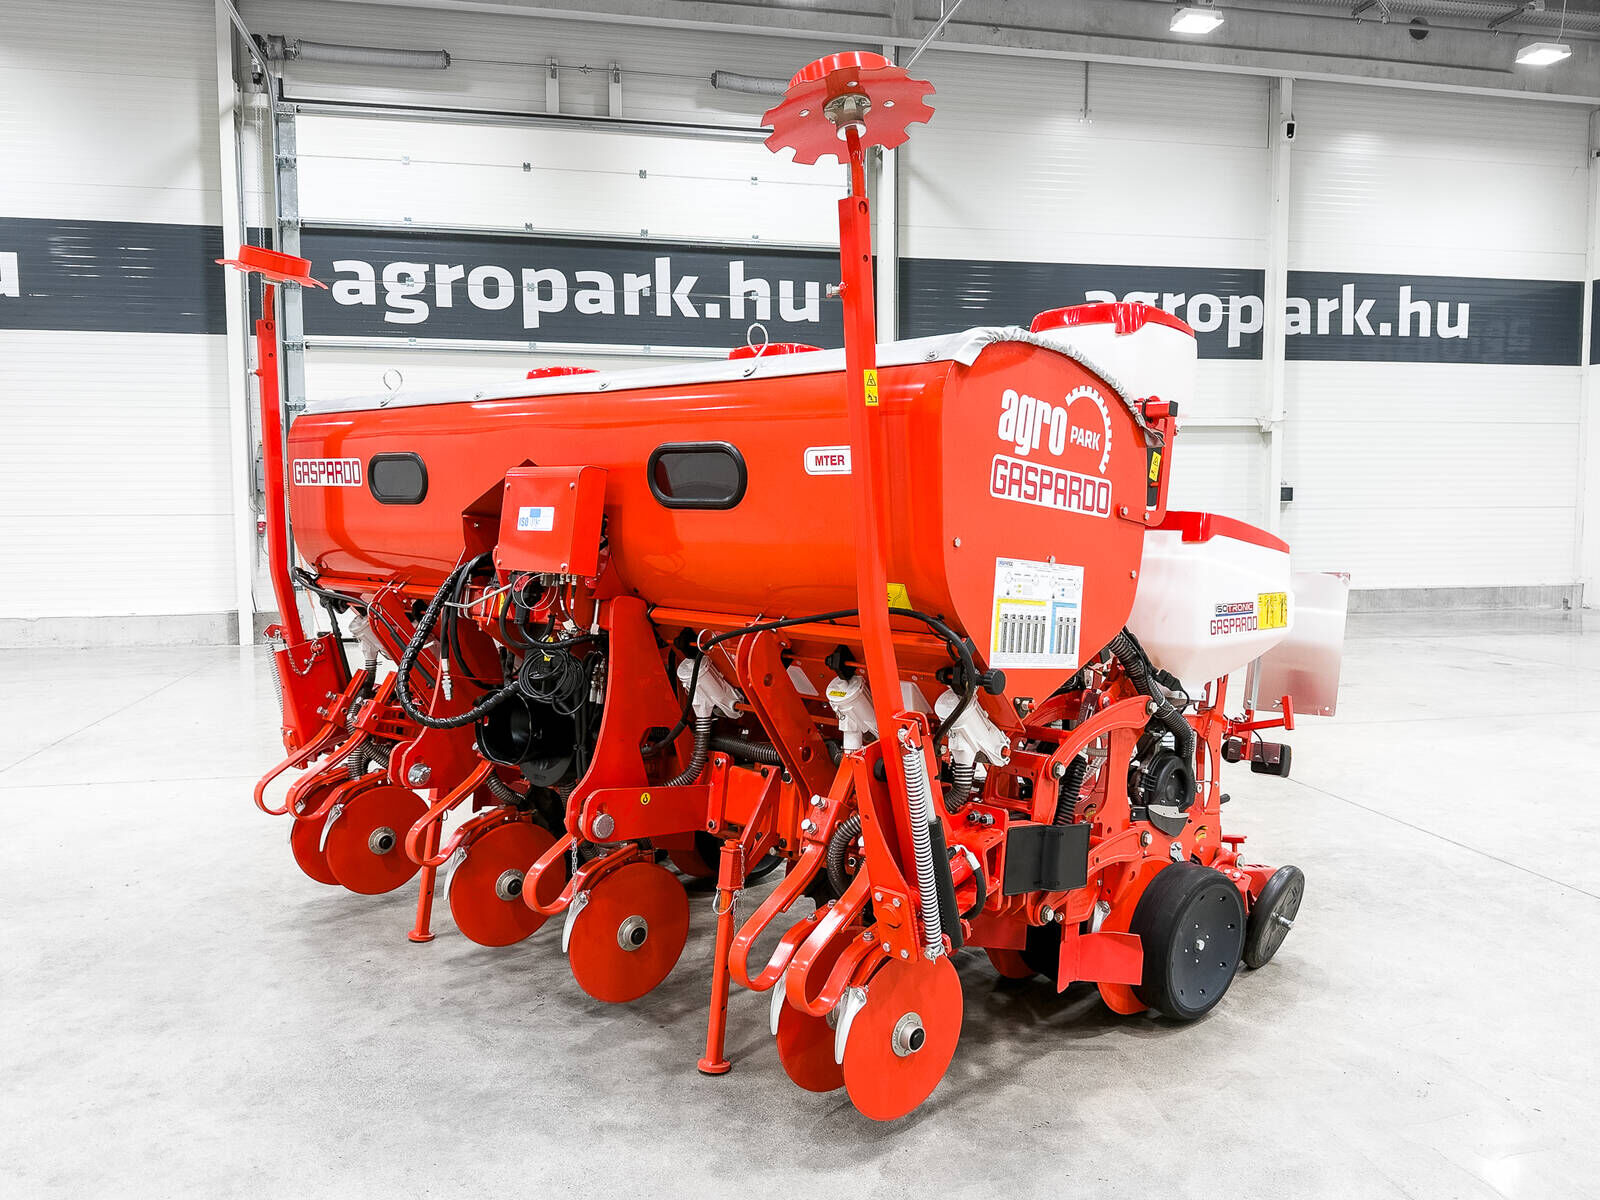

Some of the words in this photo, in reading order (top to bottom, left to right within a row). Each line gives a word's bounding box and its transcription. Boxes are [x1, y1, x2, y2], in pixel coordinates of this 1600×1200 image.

[331, 257, 820, 329] agropark.hu
[1085, 283, 1470, 348] ropark.hu
[998, 389, 1067, 456] agro
[1070, 425, 1101, 451] PARK
[294, 461, 361, 484] GASPARDO
[815, 455, 845, 466] MTER
[992, 458, 1110, 515] GASPARDO
[1210, 616, 1257, 635] GASPARDO
[1216, 603, 1253, 613] ISOTRONIC
